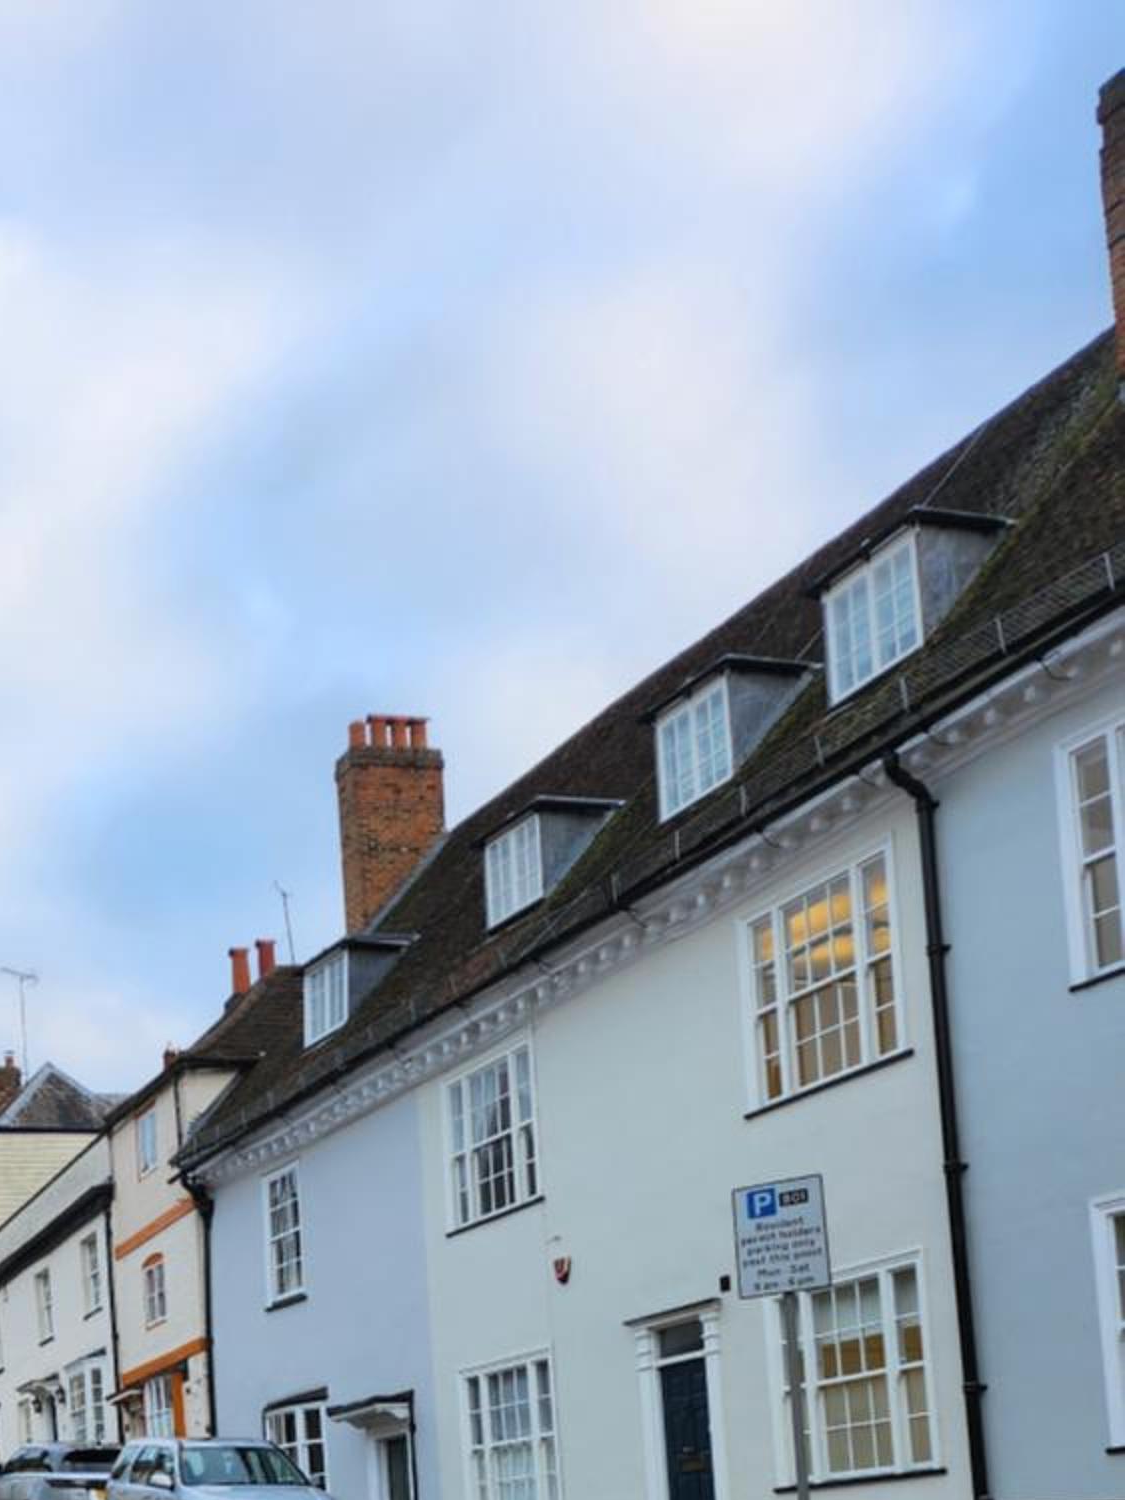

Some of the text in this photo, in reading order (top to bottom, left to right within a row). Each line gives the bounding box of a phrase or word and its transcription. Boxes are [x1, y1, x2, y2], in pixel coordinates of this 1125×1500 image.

[753, 1193, 772, 1216] P
[747, 1243, 789, 1256] parking
[790, 1263, 809, 1274] Sat
